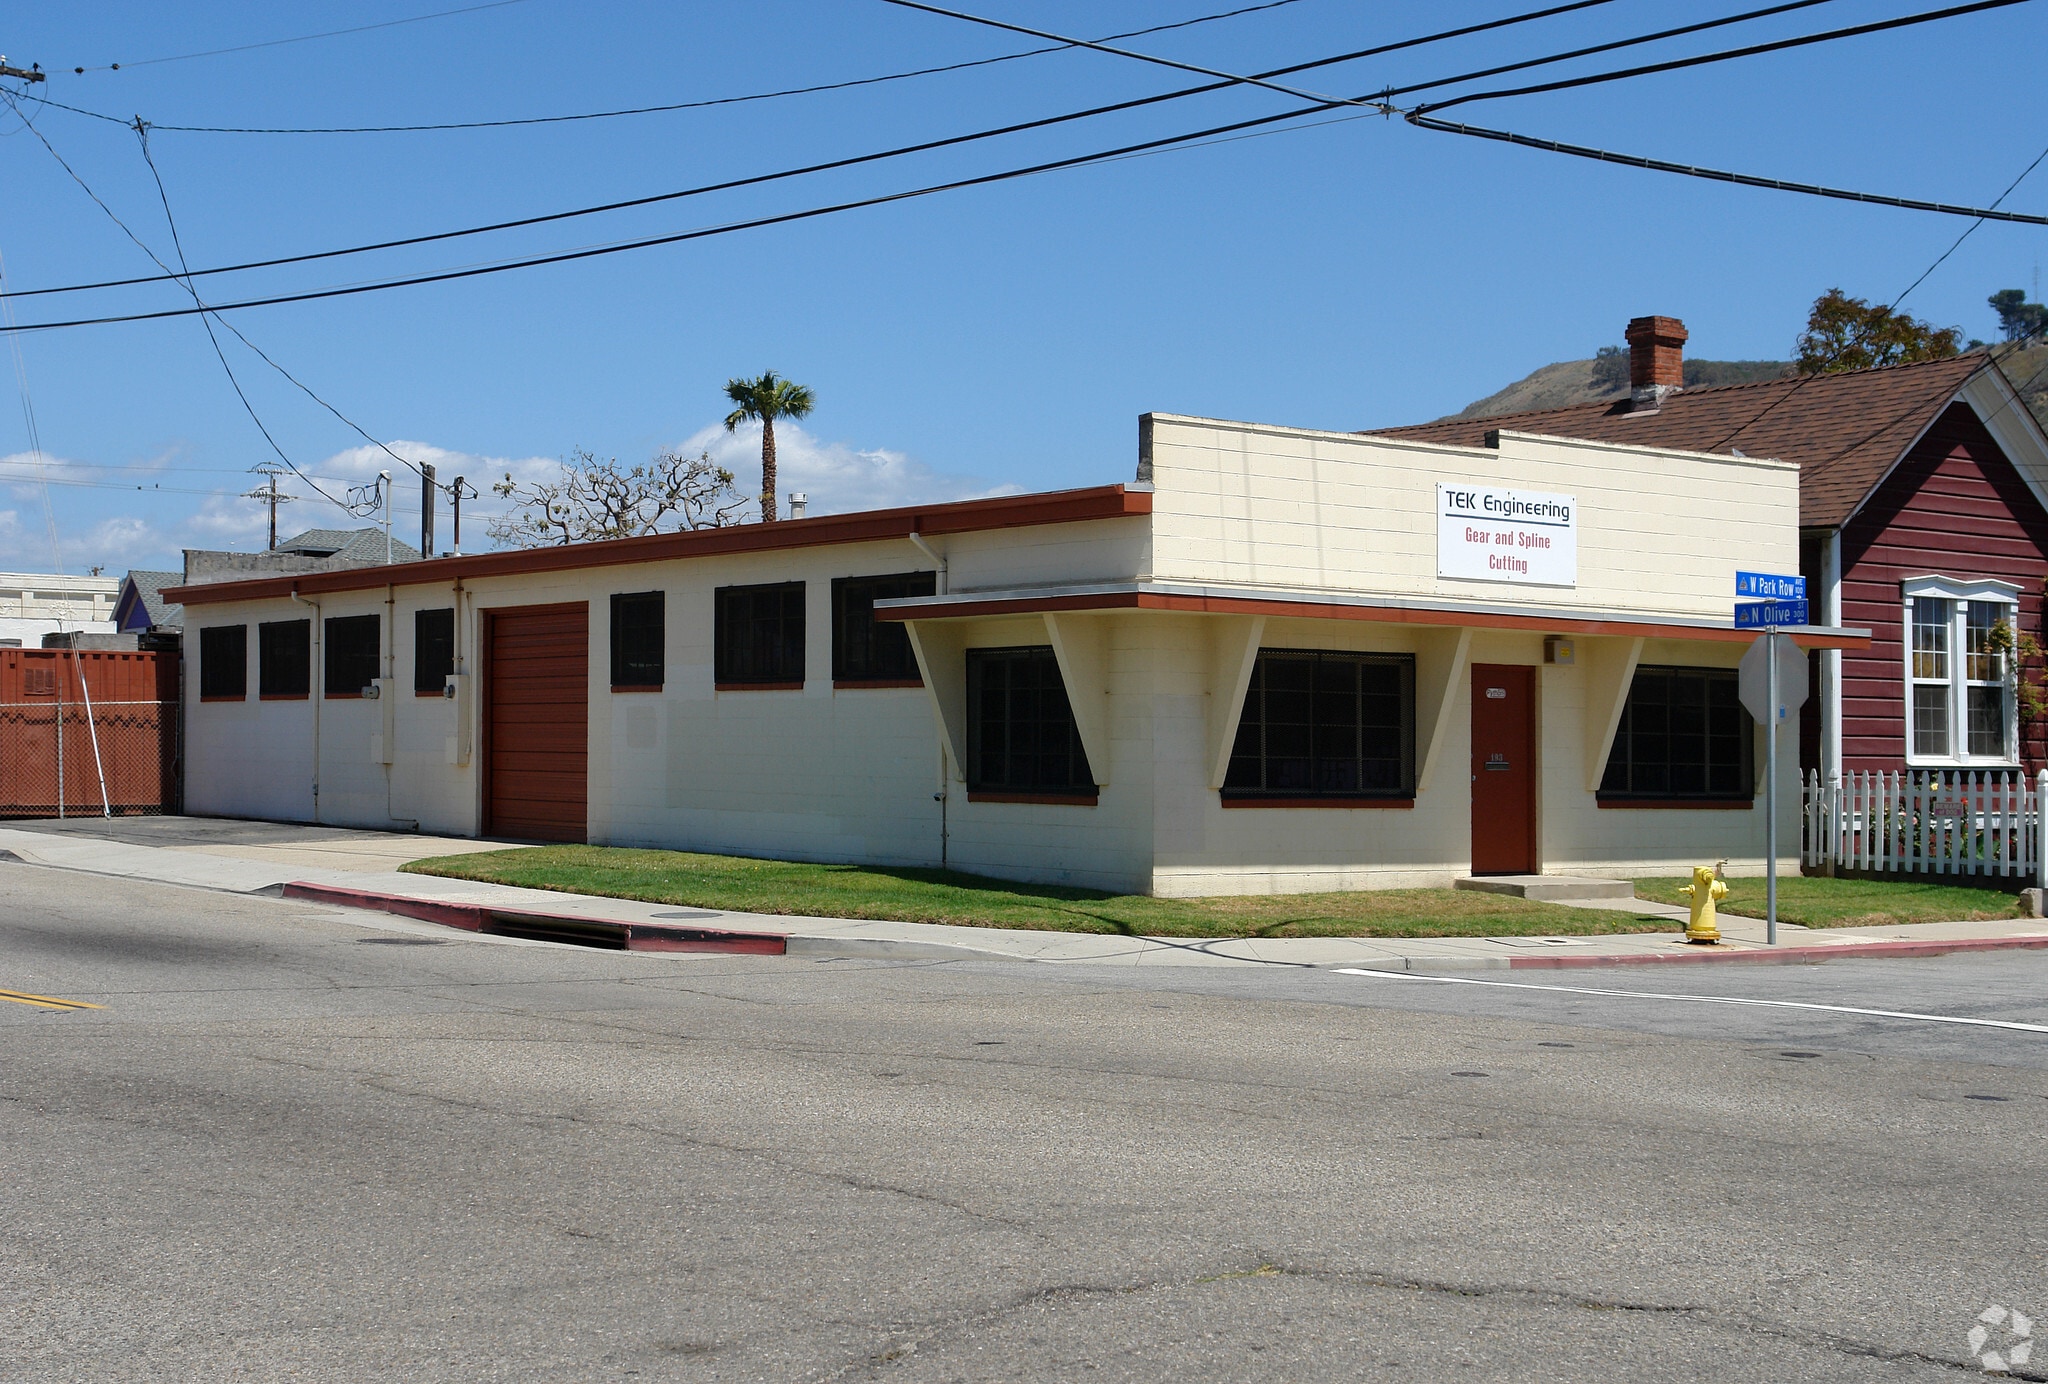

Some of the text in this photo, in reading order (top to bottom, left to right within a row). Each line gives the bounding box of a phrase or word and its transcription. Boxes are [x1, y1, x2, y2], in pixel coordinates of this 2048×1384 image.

[1445, 490, 1569, 522] TEK Engineering
[1465, 526, 1550, 549] Gear and Spline
[1489, 554, 1528, 575] Cutting
[1750, 577, 1795, 596] W Park Row
[1752, 606, 1790, 623] N Olive
